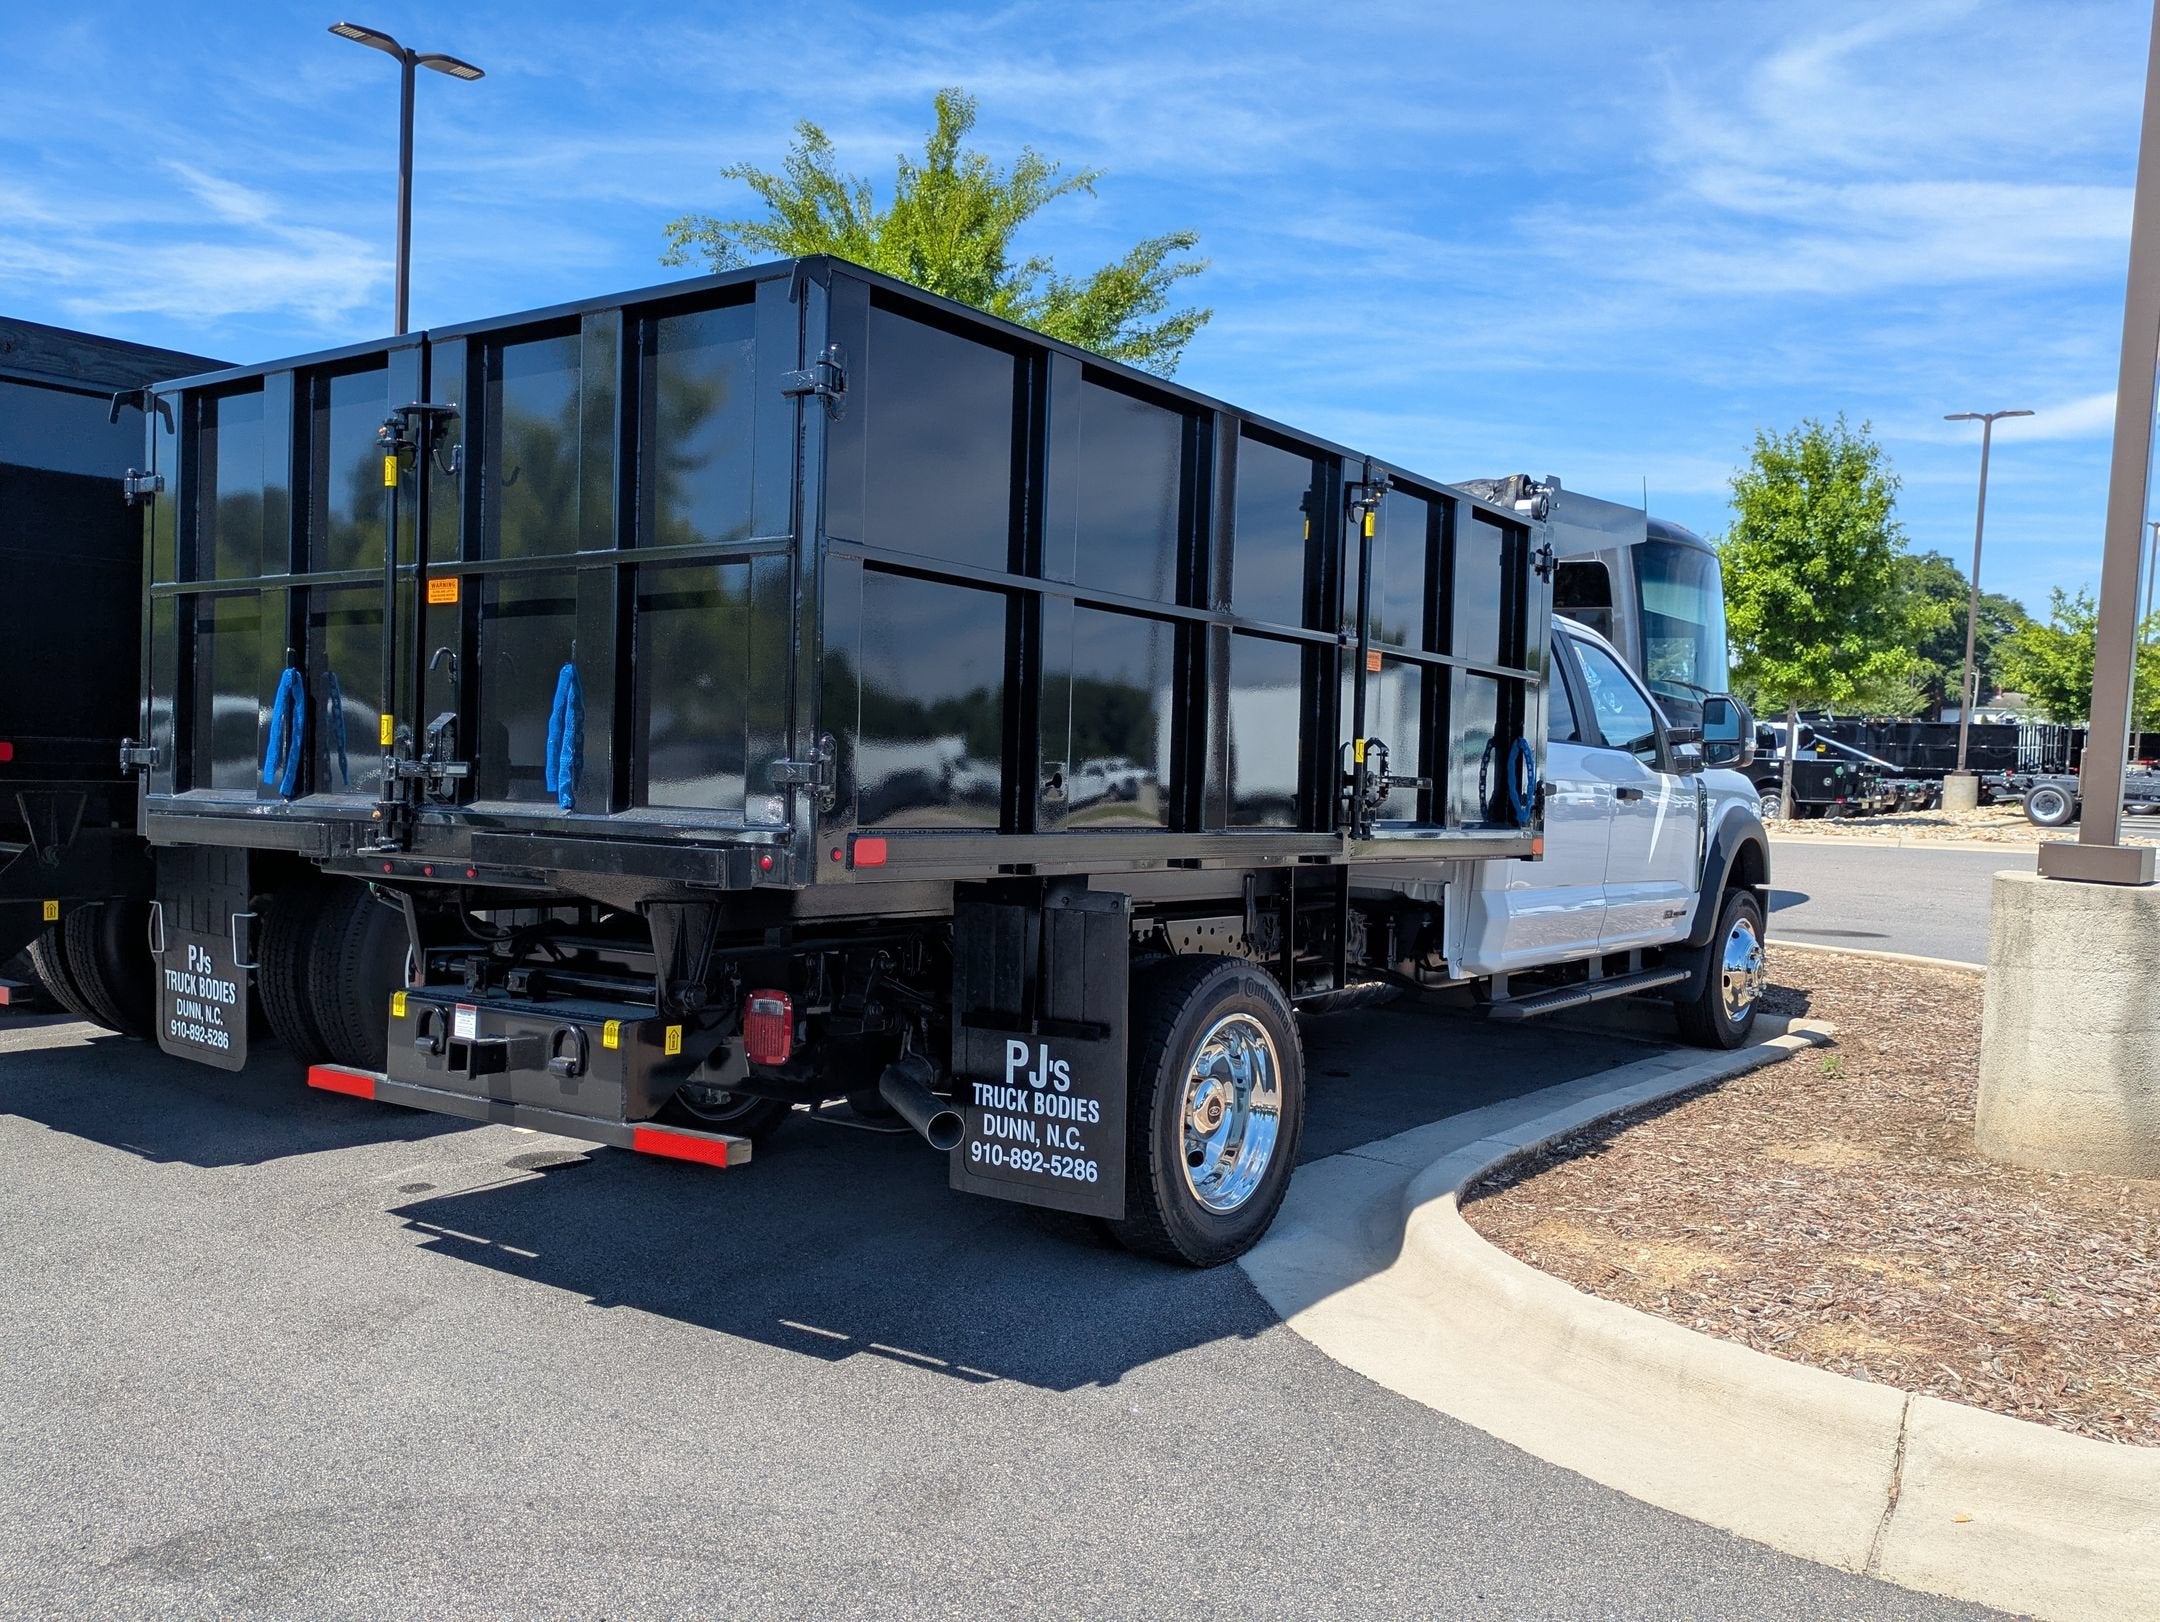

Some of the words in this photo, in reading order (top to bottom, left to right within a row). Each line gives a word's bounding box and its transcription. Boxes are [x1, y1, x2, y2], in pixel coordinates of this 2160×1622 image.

[164, 969, 197, 996] TRUCK
[199, 977, 236, 1005] BODIES
[1244, 976, 1292, 1033] Continental
[176, 998, 204, 1024] DUNN,
[205, 1005, 224, 1026] N.C.
[170, 1019, 229, 1050] 910-892-5286
[972, 1082, 1029, 1113] TRUCK
[1033, 1092, 1100, 1124] BODIES
[983, 1113, 1041, 1148] DUNN,
[1046, 1123, 1085, 1152] N.C.
[971, 1140, 1098, 1183] 910-892-5286
